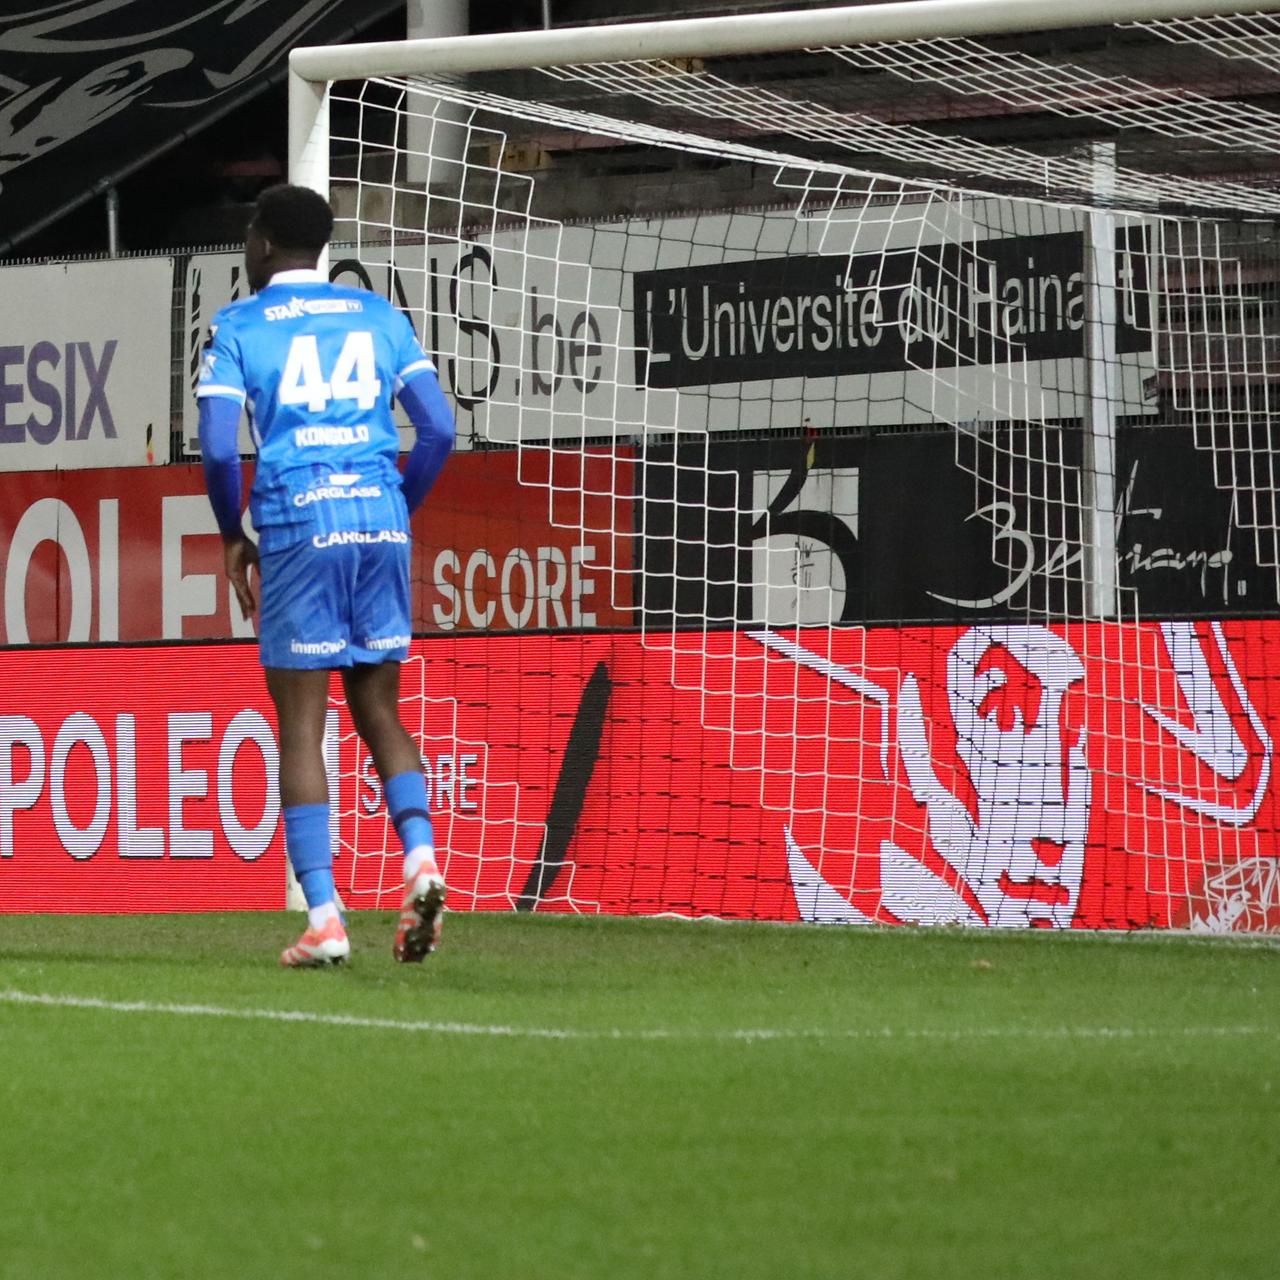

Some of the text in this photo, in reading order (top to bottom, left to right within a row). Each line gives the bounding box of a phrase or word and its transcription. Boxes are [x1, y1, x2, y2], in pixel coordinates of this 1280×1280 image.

[644, 256, 1136, 365] L'Université du Hainat
[278, 330, 382, 413] 44
[293, 485, 382, 508] CARGLASS
[431, 544, 597, 632] SCORE
[361, 753, 478, 813] SRE
